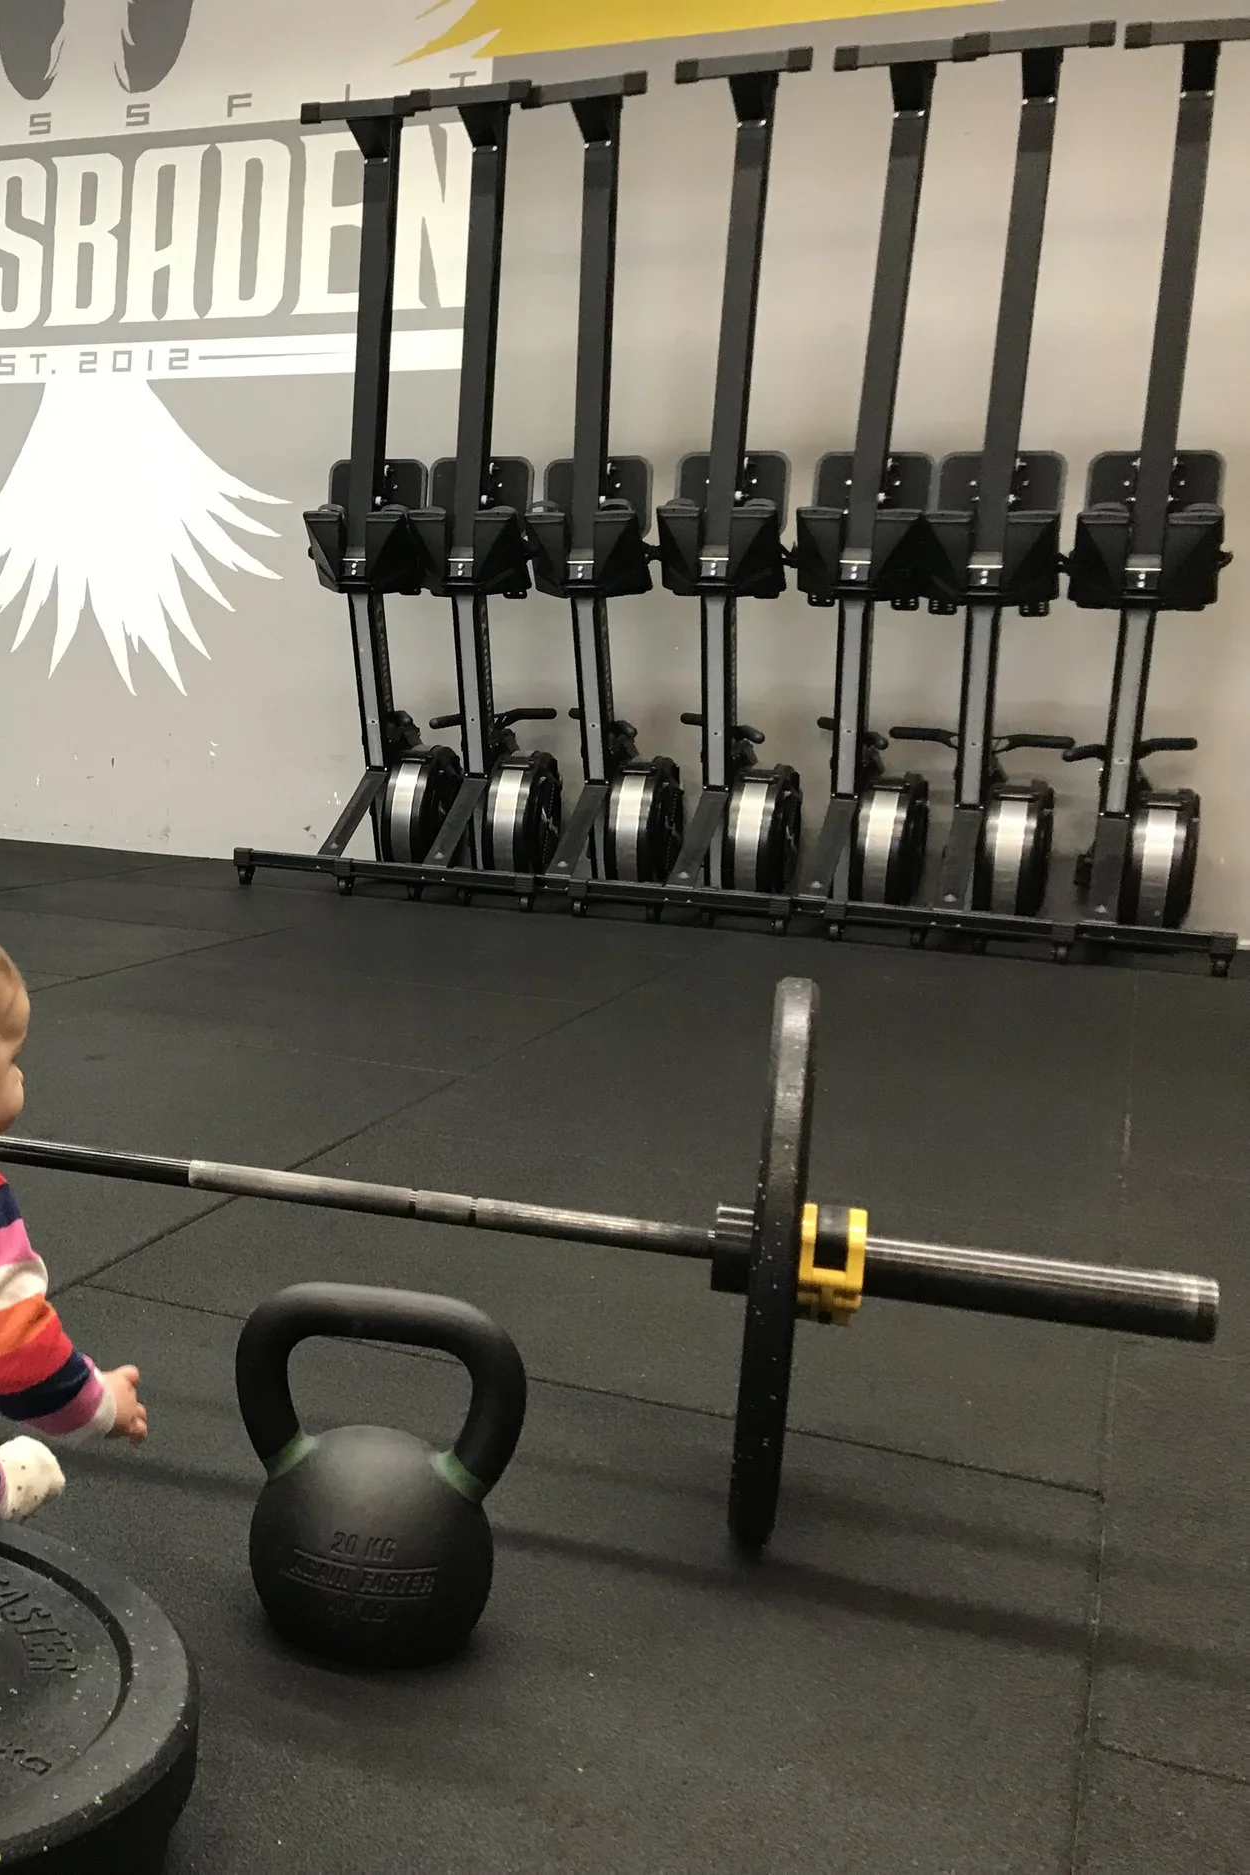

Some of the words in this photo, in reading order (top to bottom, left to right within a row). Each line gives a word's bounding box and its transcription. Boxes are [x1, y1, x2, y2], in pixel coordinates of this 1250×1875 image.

[78, 347, 192, 375] 2012
[329, 1530, 360, 1559] 20
[363, 1534, 398, 1563] KG
[358, 1571, 437, 1594] FASTER
